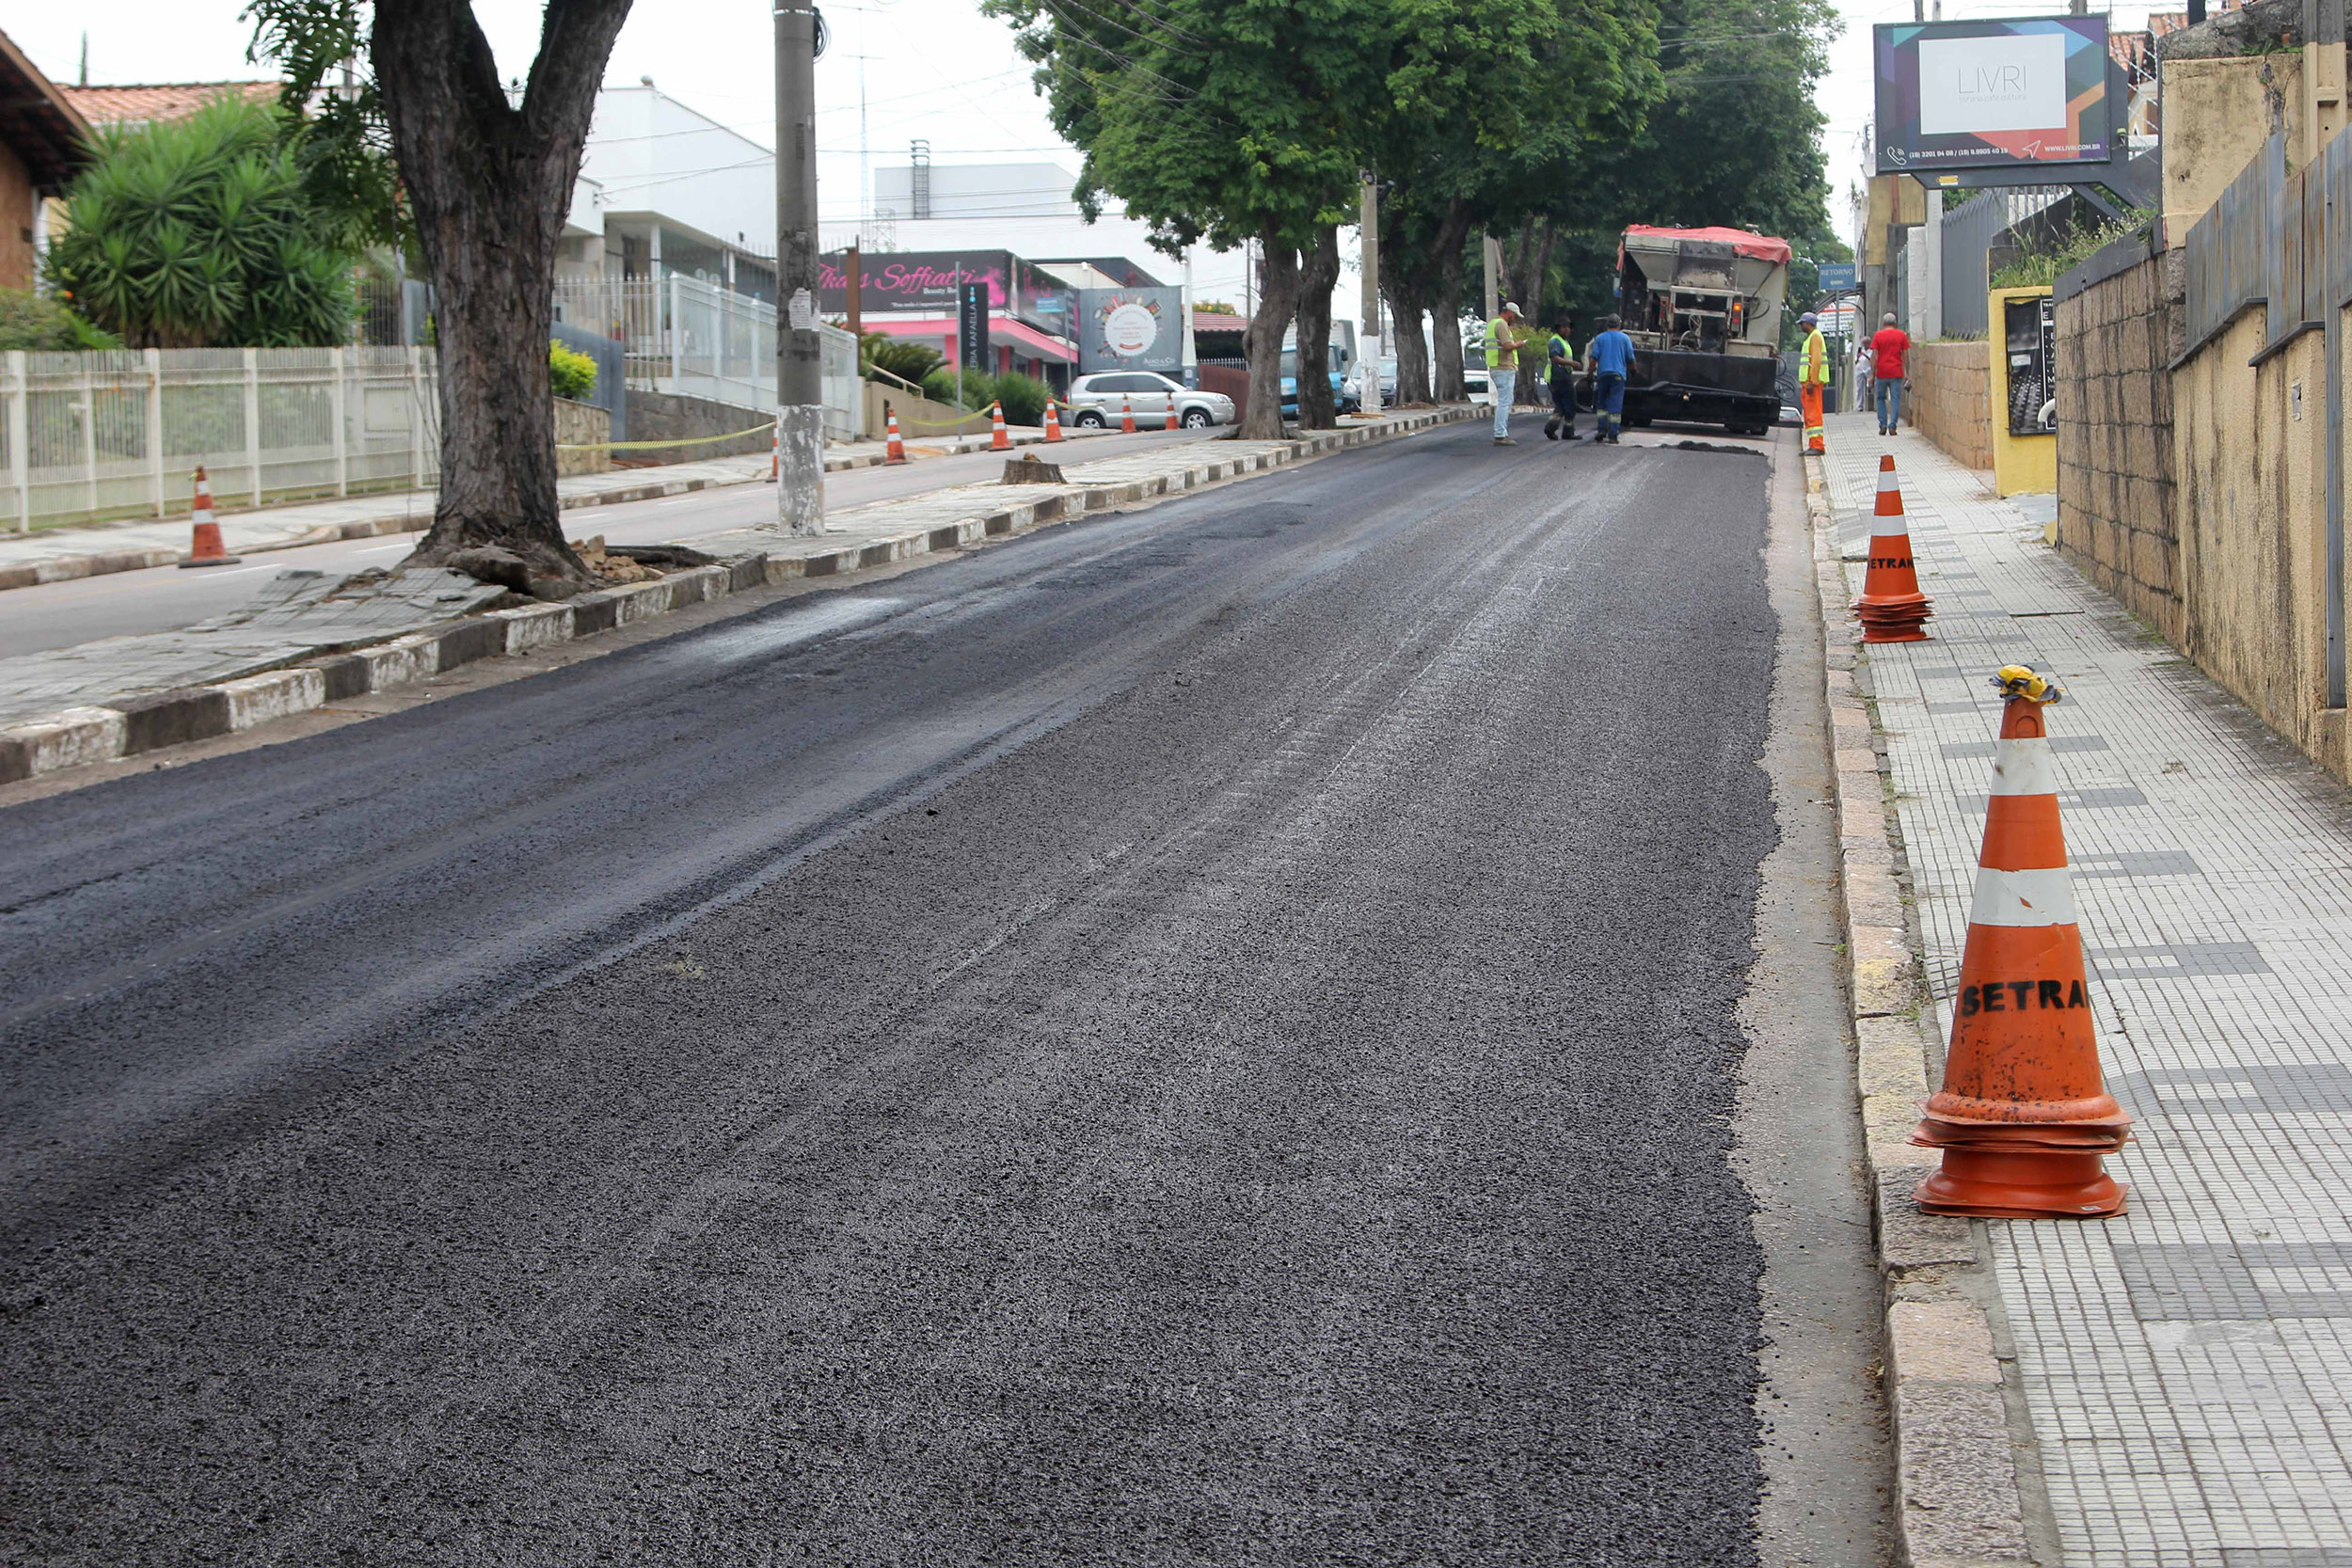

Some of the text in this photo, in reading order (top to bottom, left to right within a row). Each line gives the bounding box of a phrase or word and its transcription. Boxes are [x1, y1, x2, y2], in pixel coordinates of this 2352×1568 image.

[1958, 65, 2026, 94] LIVRI
[818, 262, 870, 291] Thas
[969, 303, 977, 347] RAFAELLA
[1867, 558, 1915, 569] ETRAN
